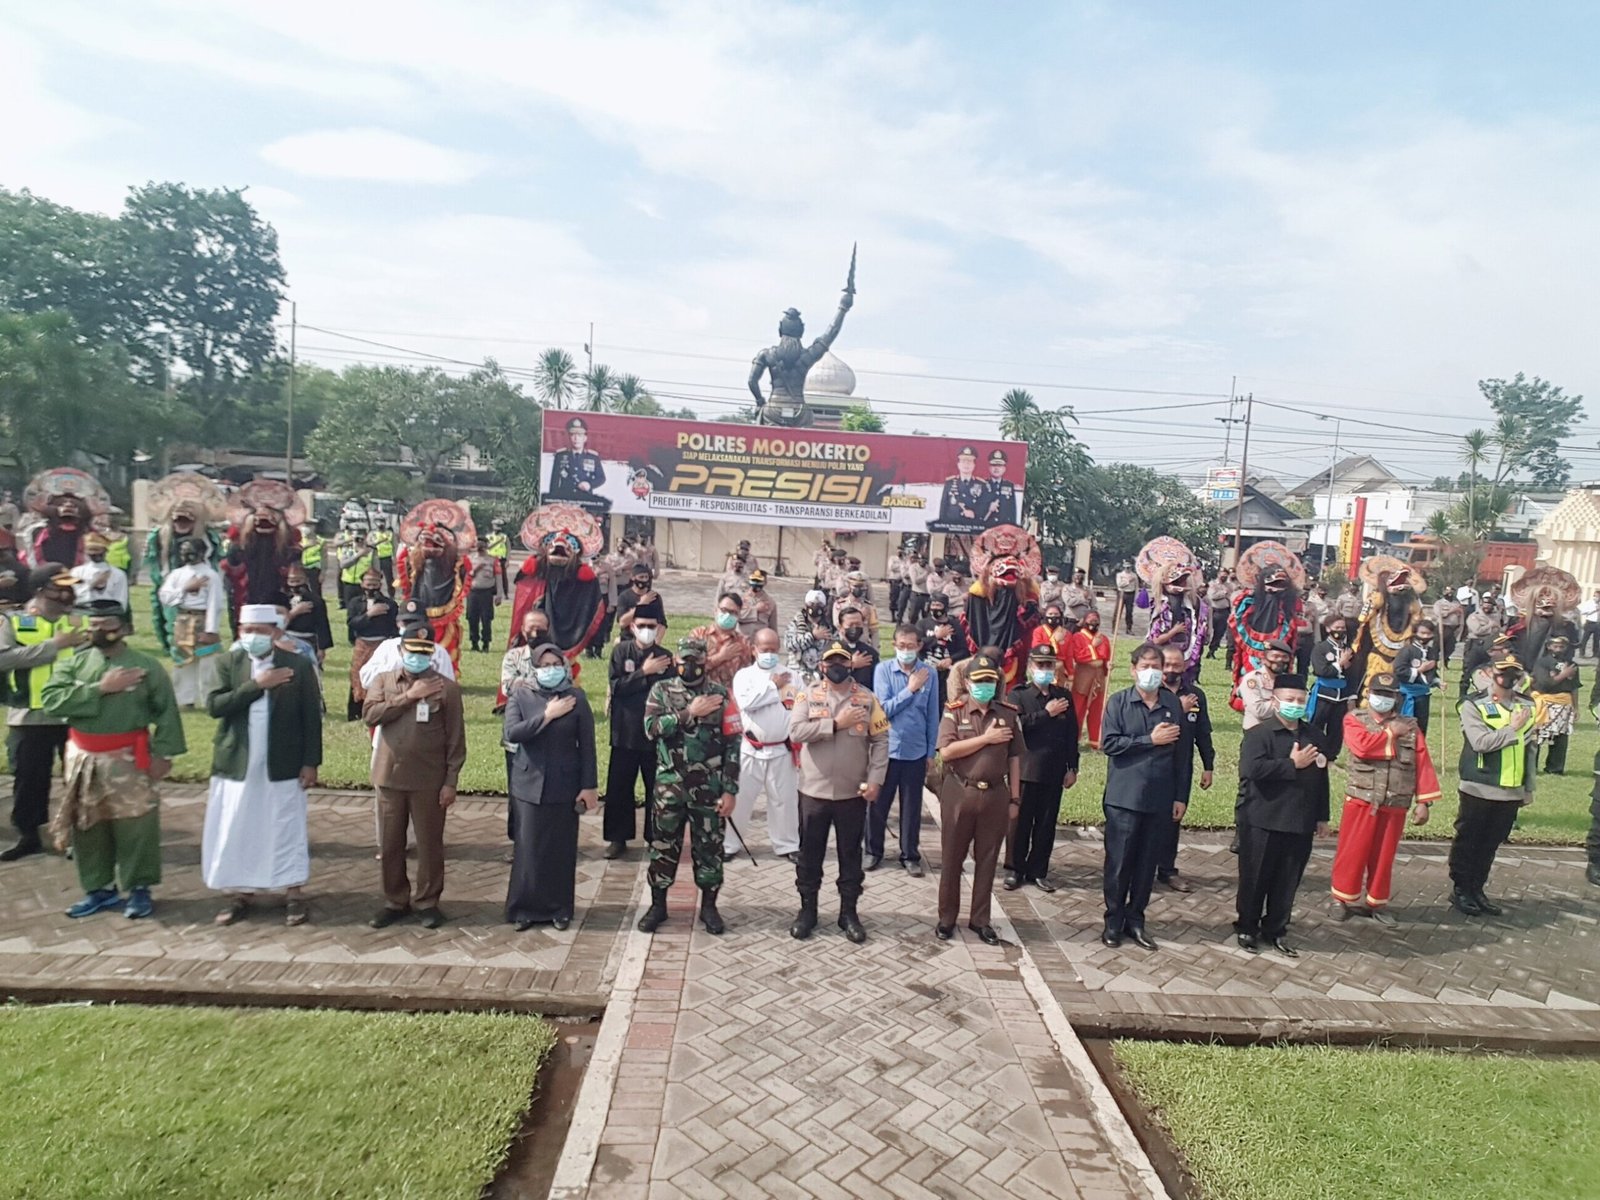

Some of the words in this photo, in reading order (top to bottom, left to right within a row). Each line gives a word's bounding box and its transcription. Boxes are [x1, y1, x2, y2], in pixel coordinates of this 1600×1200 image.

[677, 432, 747, 454] POLRES
[752, 438, 871, 462] MOJOKERTO
[682, 451, 697, 460] SIAP
[698, 452, 751, 464] MELAKSANAKAN
[752, 456, 801, 468] TRANSFORMASI
[828, 462, 846, 471] POLRI
[847, 463, 865, 472] YANG
[669, 464, 873, 504] PRESISI
[652, 495, 693, 508] PREDIKTIF
[700, 499, 768, 514] RESPONSIBILITAS
[775, 505, 834, 518] TRANSPARANSI
[834, 509, 888, 521] BERKEADILAN
